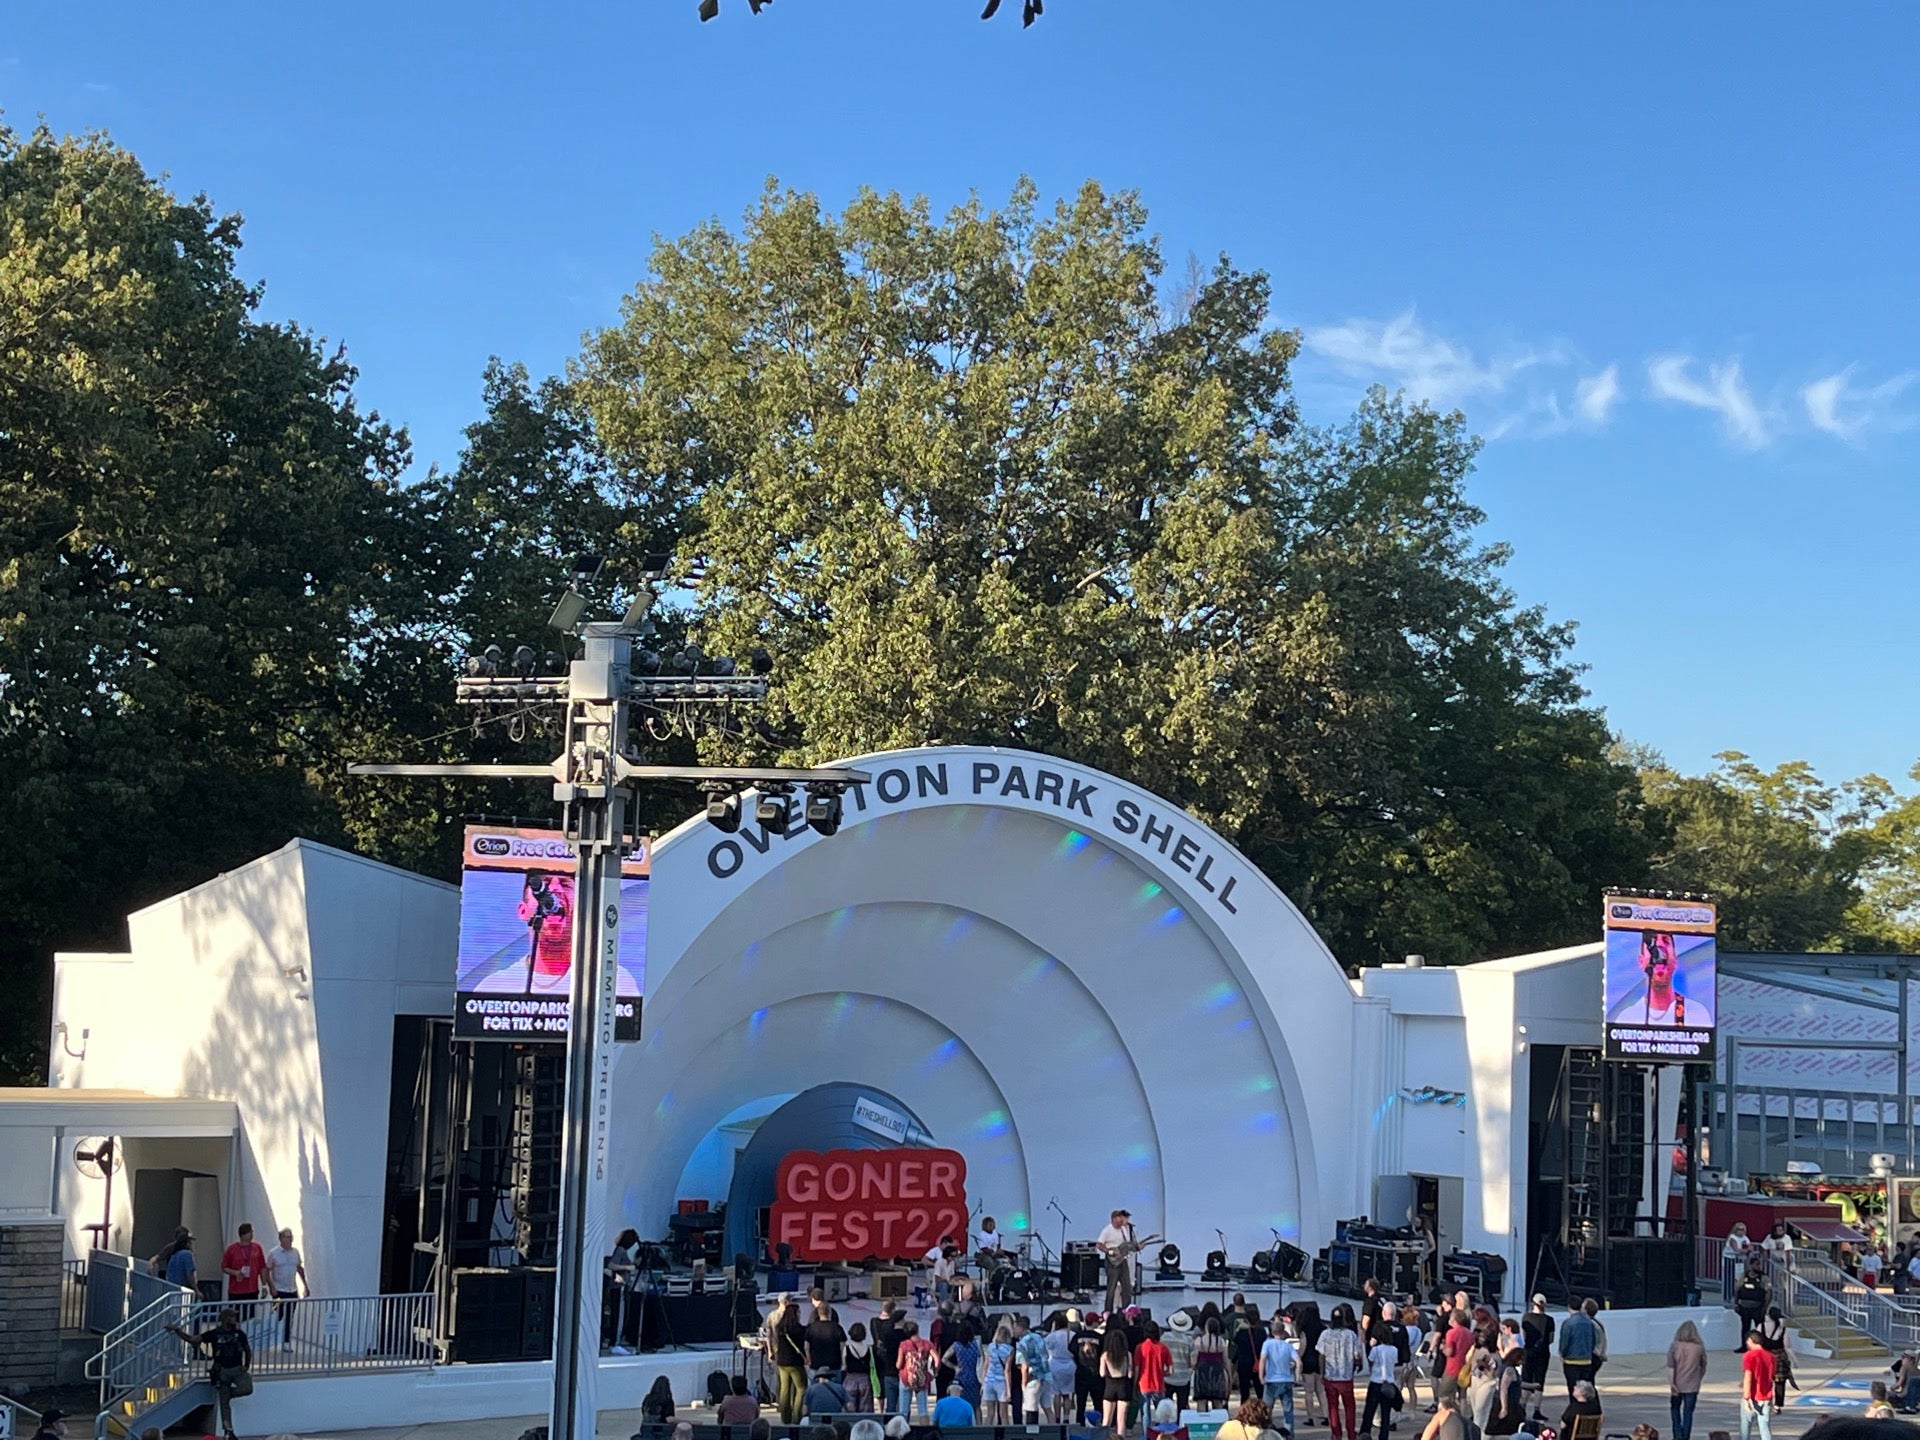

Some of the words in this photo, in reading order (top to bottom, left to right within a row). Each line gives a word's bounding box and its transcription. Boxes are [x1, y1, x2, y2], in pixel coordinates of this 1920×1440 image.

[477, 838, 507, 852] Orion
[512, 840, 544, 856] Free
[707, 763, 949, 879] OVETON
[972, 762, 1099, 817] PARK
[1112, 799, 1238, 915] SHELL
[603, 939, 615, 1045] MEMPHO
[483, 1016, 511, 1031] FOR
[512, 1017, 533, 1031] TIX
[1610, 1028, 1710, 1043] OVERTONPARKSHELL.ORG
[1621, 1041, 1638, 1053] FOR
[1638, 1042, 1651, 1053] TIX
[1657, 1043, 1679, 1054] MORE
[1680, 1044, 1700, 1055] INFO
[786, 1160, 958, 1203] GONER
[780, 1207, 961, 1251] FEST22
